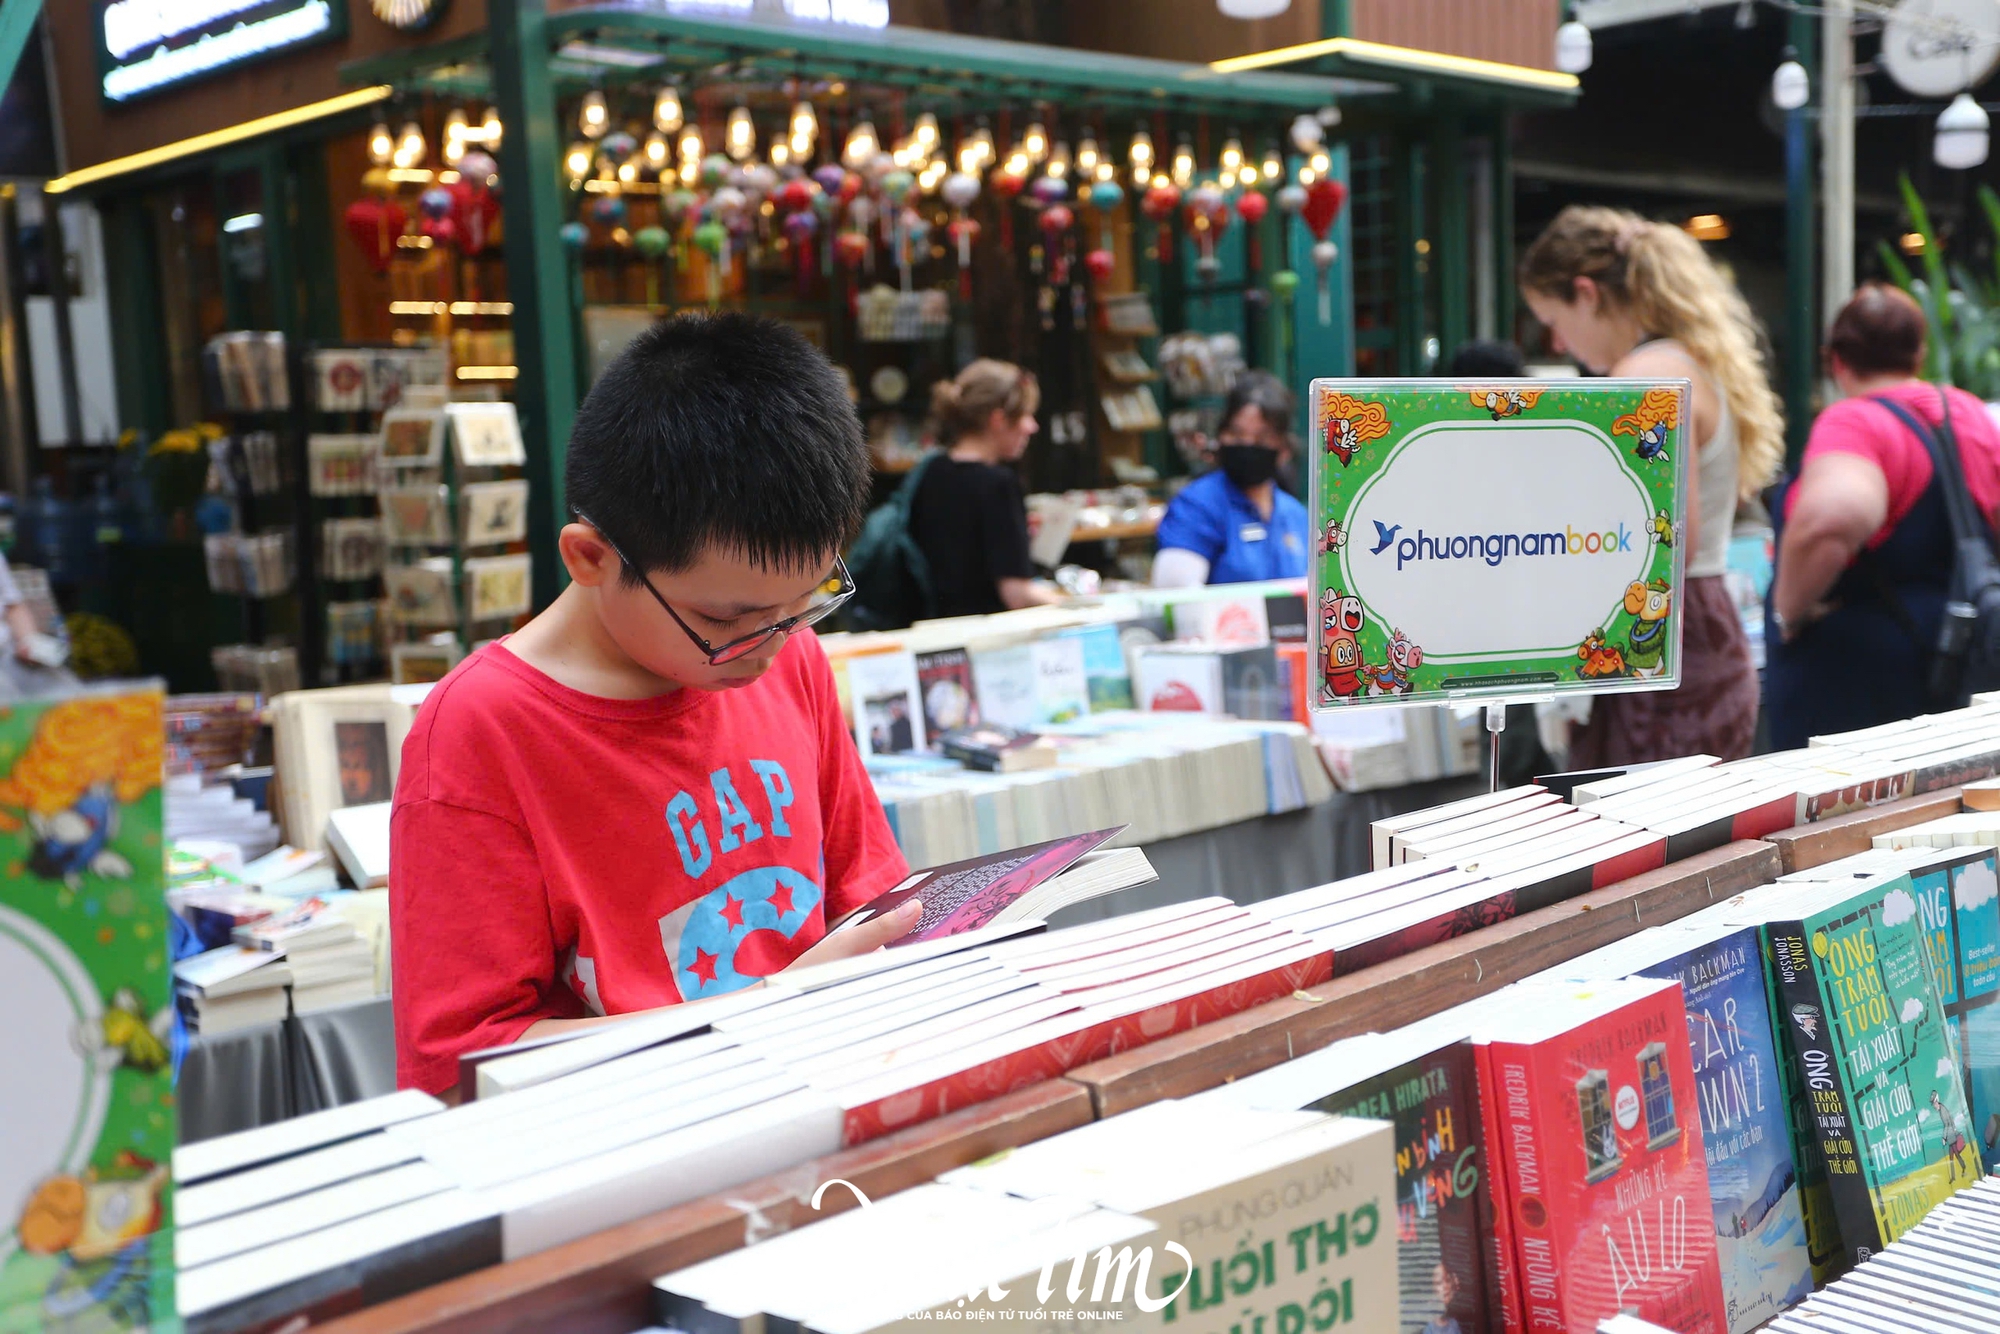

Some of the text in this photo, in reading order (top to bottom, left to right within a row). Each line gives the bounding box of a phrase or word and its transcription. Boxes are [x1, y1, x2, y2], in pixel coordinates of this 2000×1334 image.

[1397, 522, 1632, 571] phuongnambook
[666, 760, 794, 879] GAP
[1918, 887, 1947, 931] NG
[1691, 947, 1746, 984] BACKMAN
[1774, 937, 1796, 983] JONASSON
[1787, 936, 1808, 971] JONAS
[1829, 927, 1875, 977] ÔNG
[1834, 965, 1881, 1008] TRĂM
[1803, 1049, 1833, 1089] ÔNG
[1850, 1040, 1873, 1078] TÁI
[1871, 1020, 1900, 1065] XUẤT
[1394, 1067, 1449, 1112] HIRATA
[1700, 1062, 1751, 1134] WN
[1750, 1054, 1765, 1112] 2
[1875, 1068, 1889, 1090] VÀ
[1503, 1063, 1541, 1196] FREDRIK BACKMAN
[1862, 1090, 1889, 1130] GIẢI
[1871, 1119, 1922, 1172] THẾ GIỚI
[1287, 1197, 1381, 1275] THƠ
[1659, 1195, 1685, 1271] LO
[1522, 1236, 1560, 1300] NHỮNG
